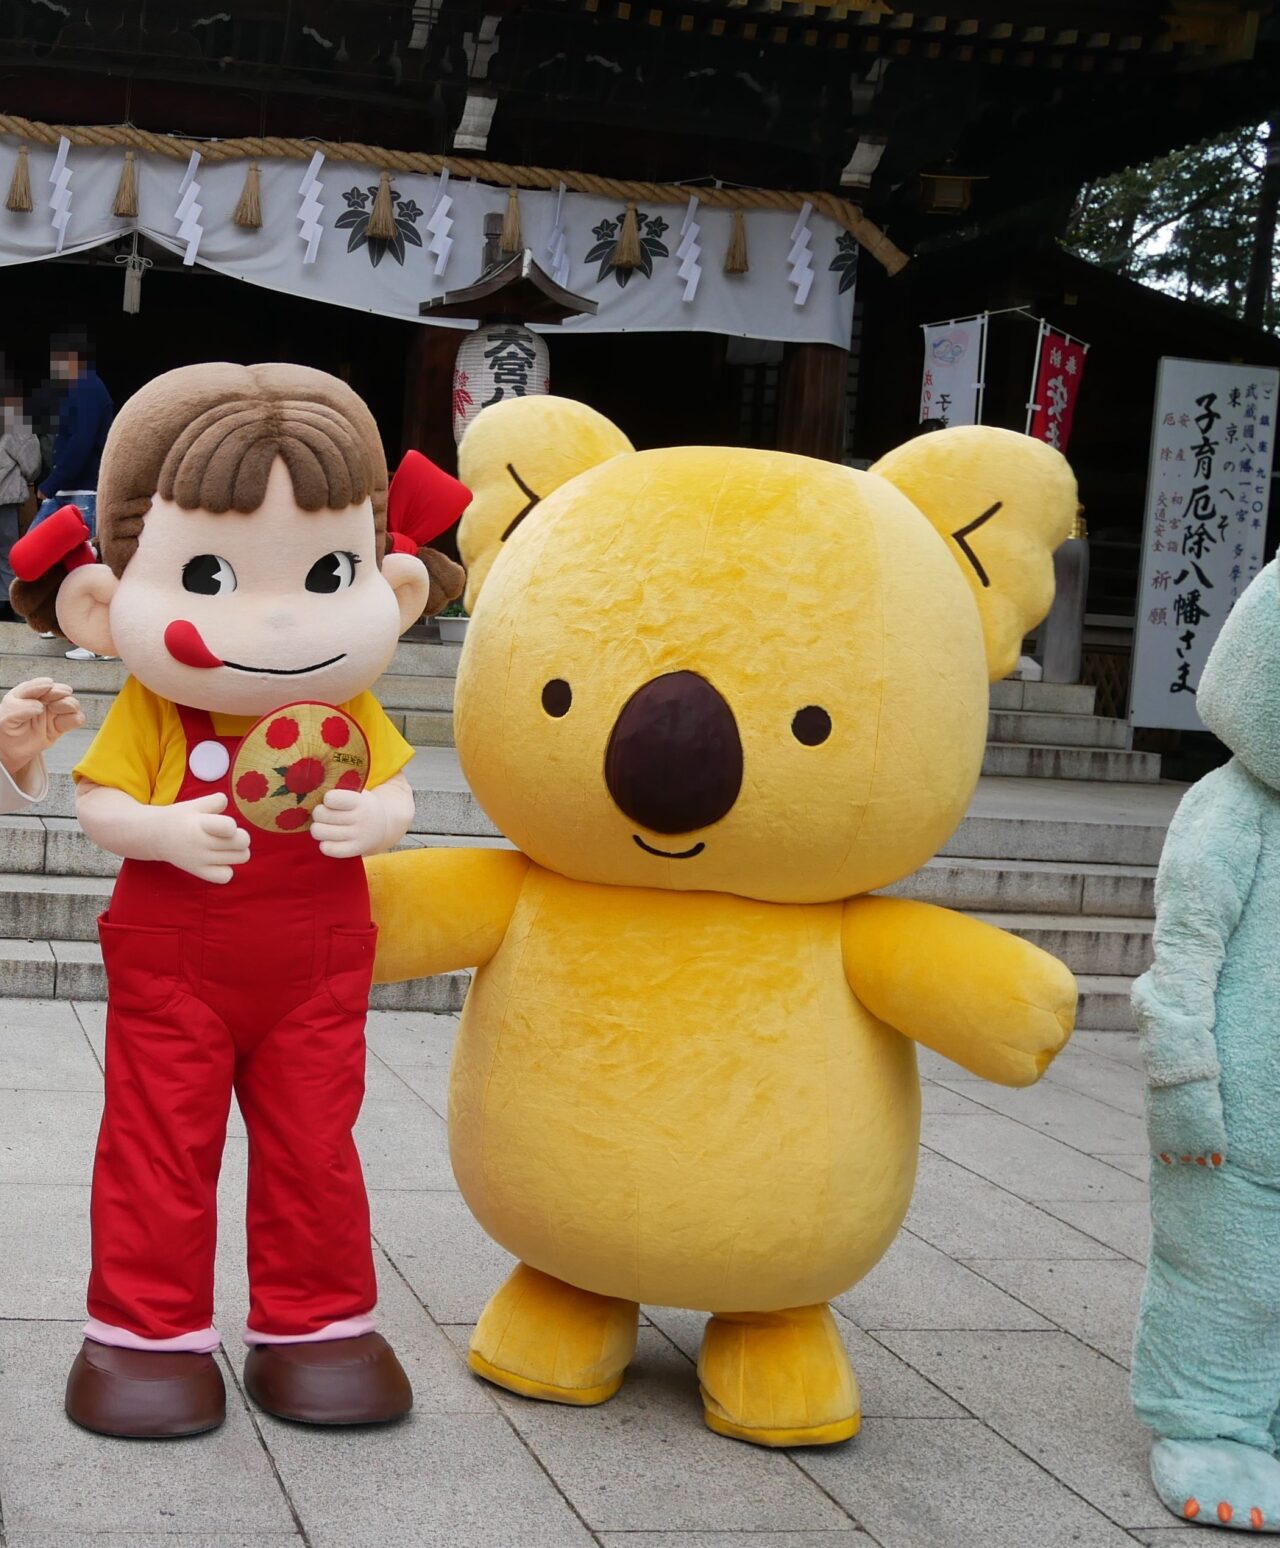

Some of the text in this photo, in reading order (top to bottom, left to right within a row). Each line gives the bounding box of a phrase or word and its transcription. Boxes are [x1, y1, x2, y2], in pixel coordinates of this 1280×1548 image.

[1170, 392, 1222, 696] 子育厄除八幡さま
[1219, 387, 1241, 543] 東京のへそ
